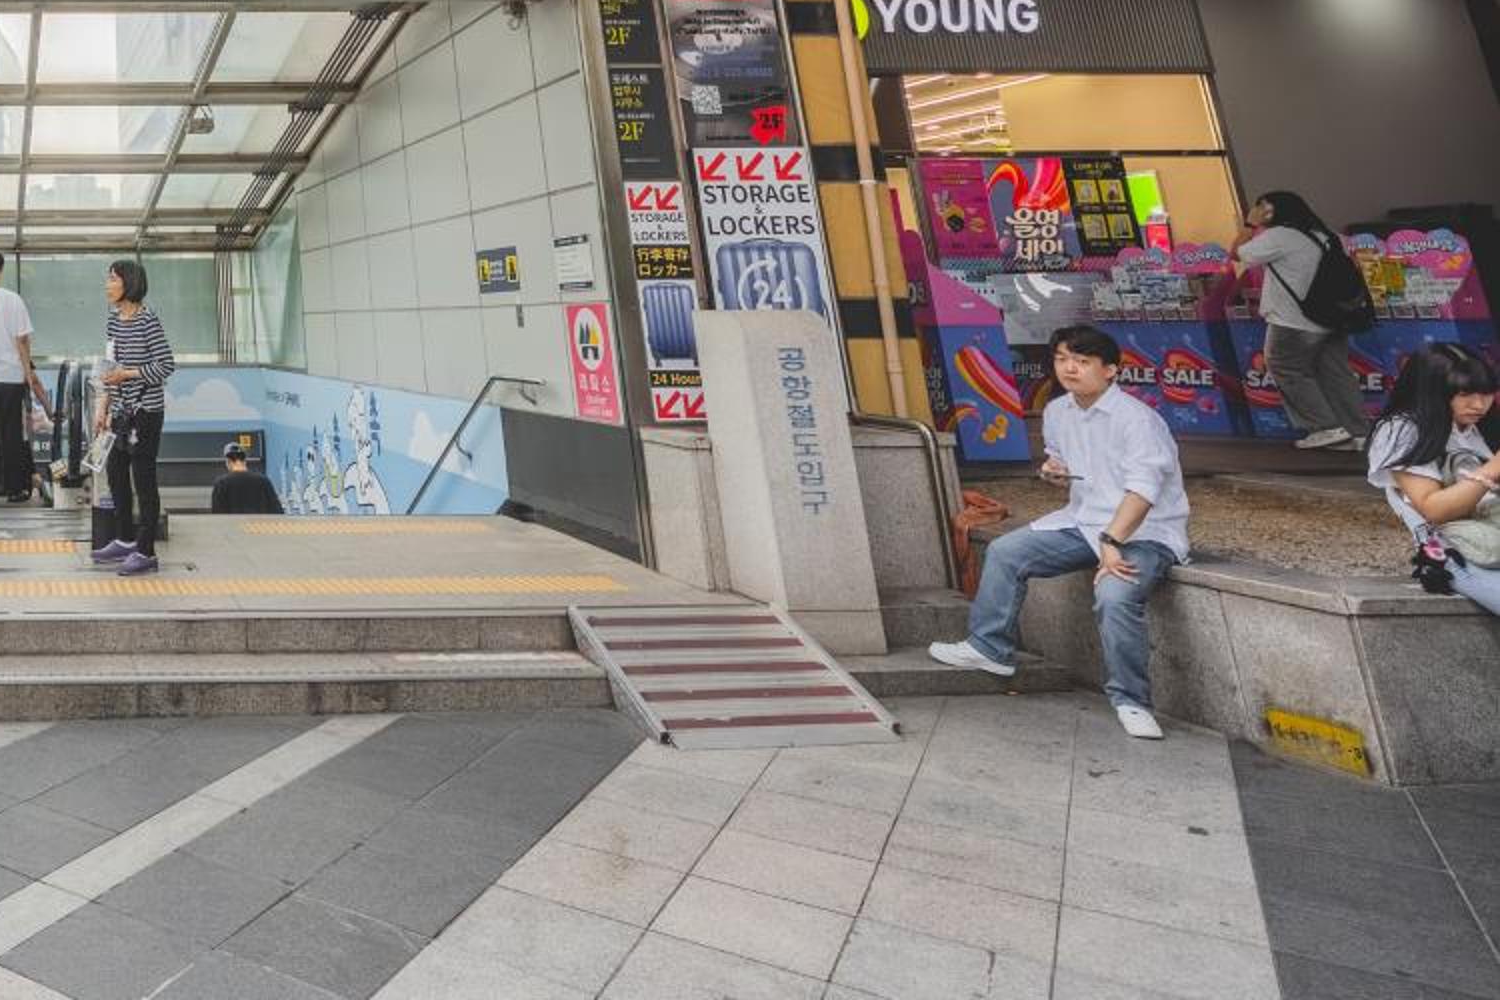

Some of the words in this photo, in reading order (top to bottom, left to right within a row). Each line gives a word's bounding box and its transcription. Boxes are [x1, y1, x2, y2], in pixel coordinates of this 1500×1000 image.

[606, 25, 631, 46] 2F
[618, 120, 645, 142] 2F
[702, 183, 811, 204] STORAGE
[630, 212, 685, 223] STORAGE
[754, 203, 763, 215] &
[706, 214, 816, 236] LOCKERS
[1006, 207, 1061, 239] 올영
[634, 231, 688, 242] LOCKERS
[638, 263, 692, 277] ロッカー
[752, 279, 793, 309] 24
[651, 372, 669, 386] 24
[1117, 367, 1156, 384] ALE
[1163, 369, 1214, 386] SALE
